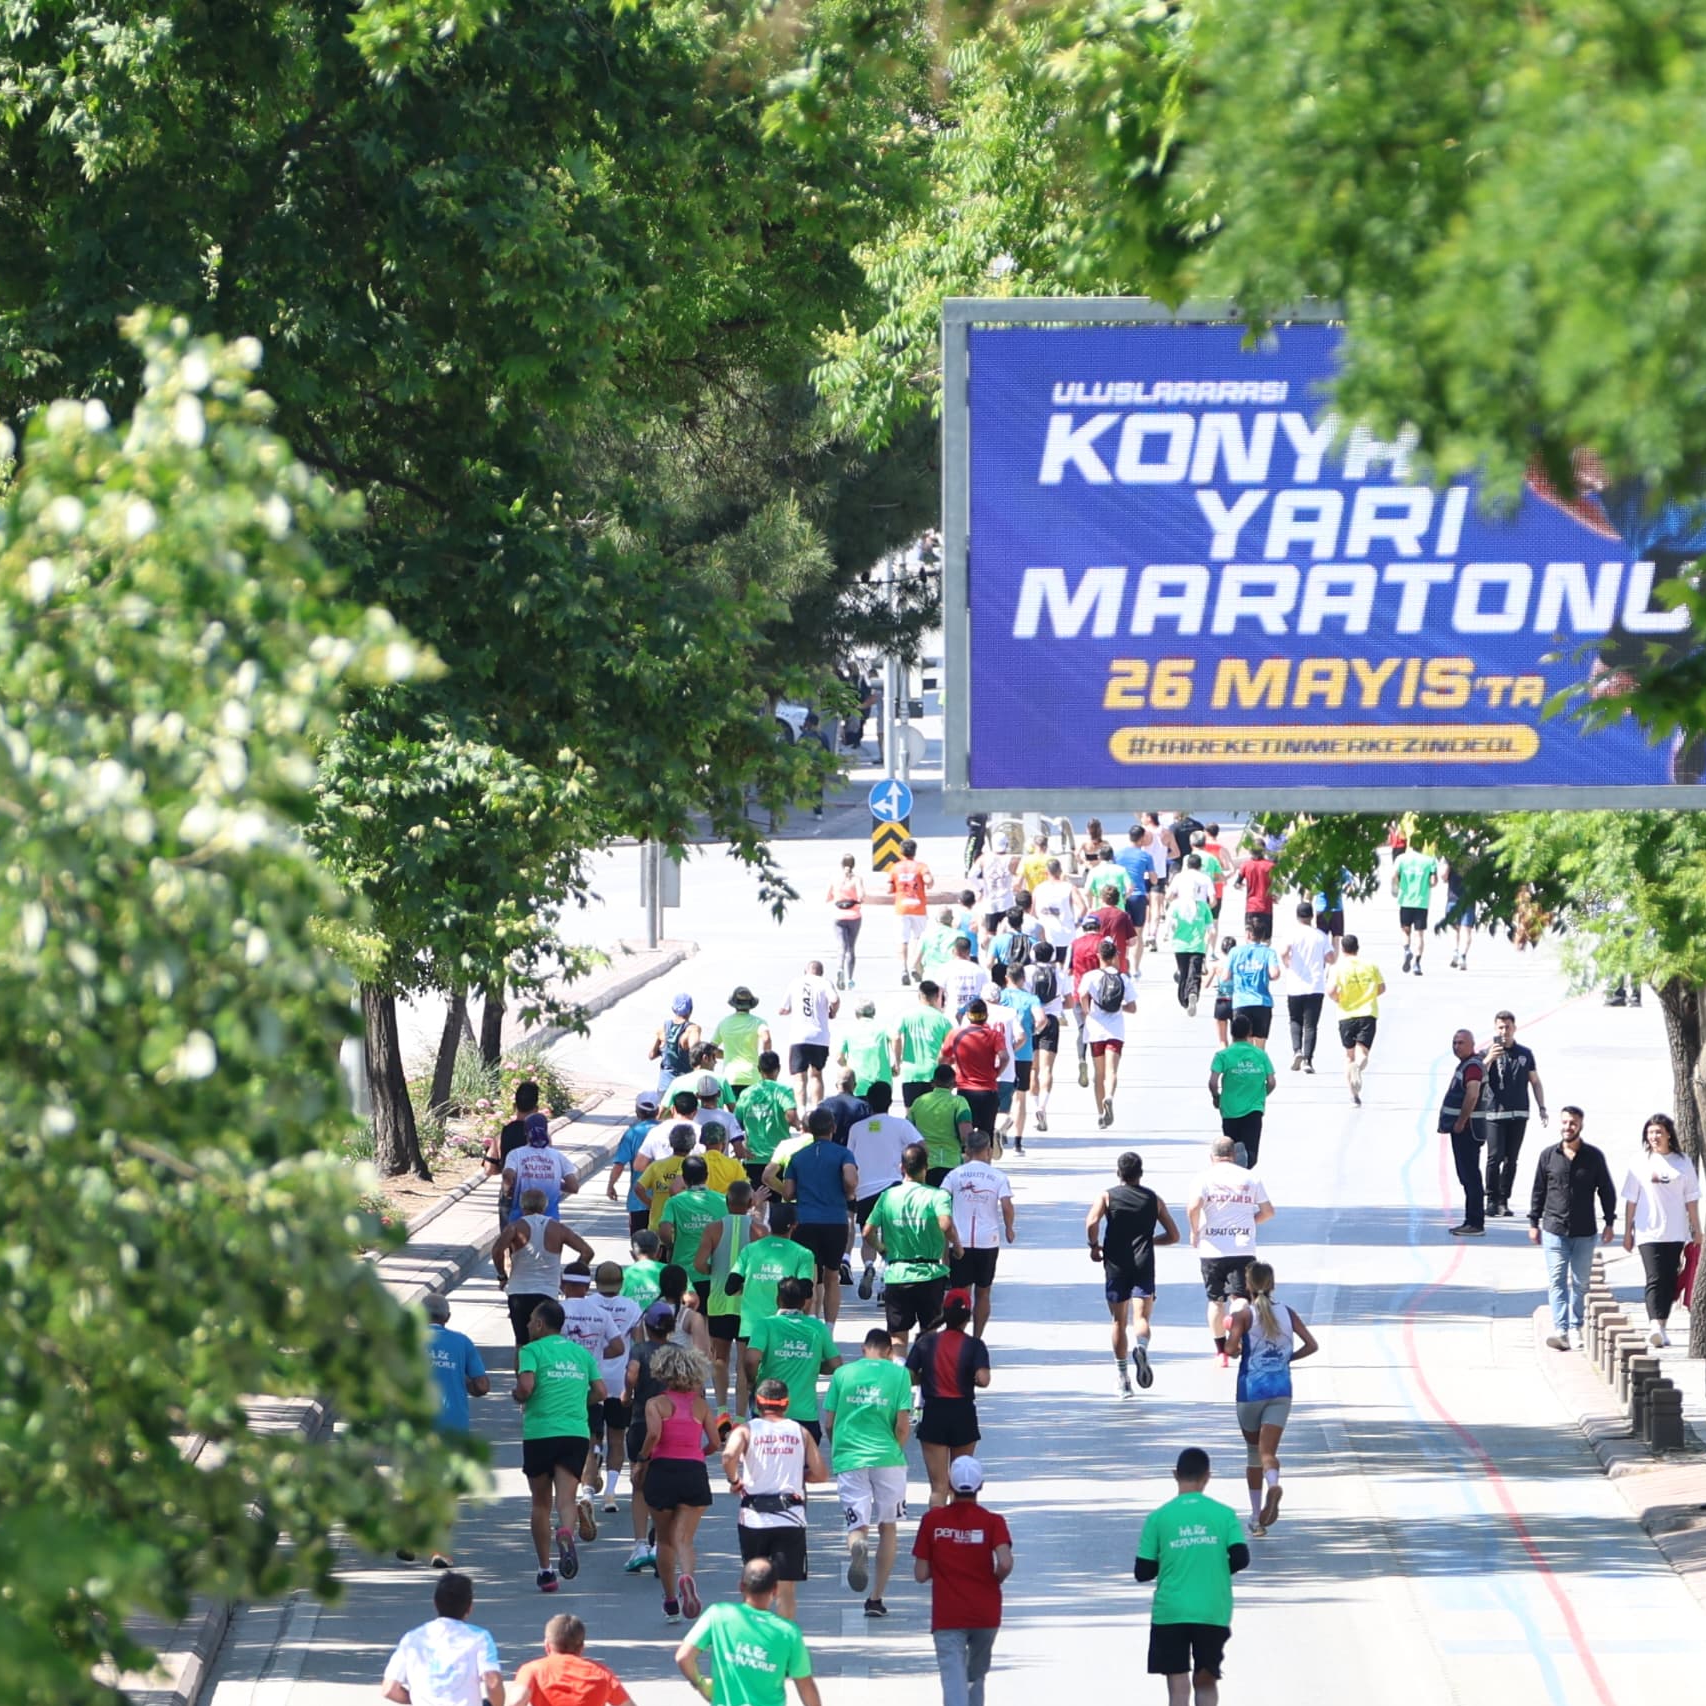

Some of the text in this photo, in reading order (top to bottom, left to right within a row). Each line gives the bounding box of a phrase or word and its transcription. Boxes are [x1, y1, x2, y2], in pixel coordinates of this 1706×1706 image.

[1052, 381, 1288, 405] ULUSLARARASI
[1195, 486, 1470, 562] YARI
[1103, 657, 1196, 710] 26
